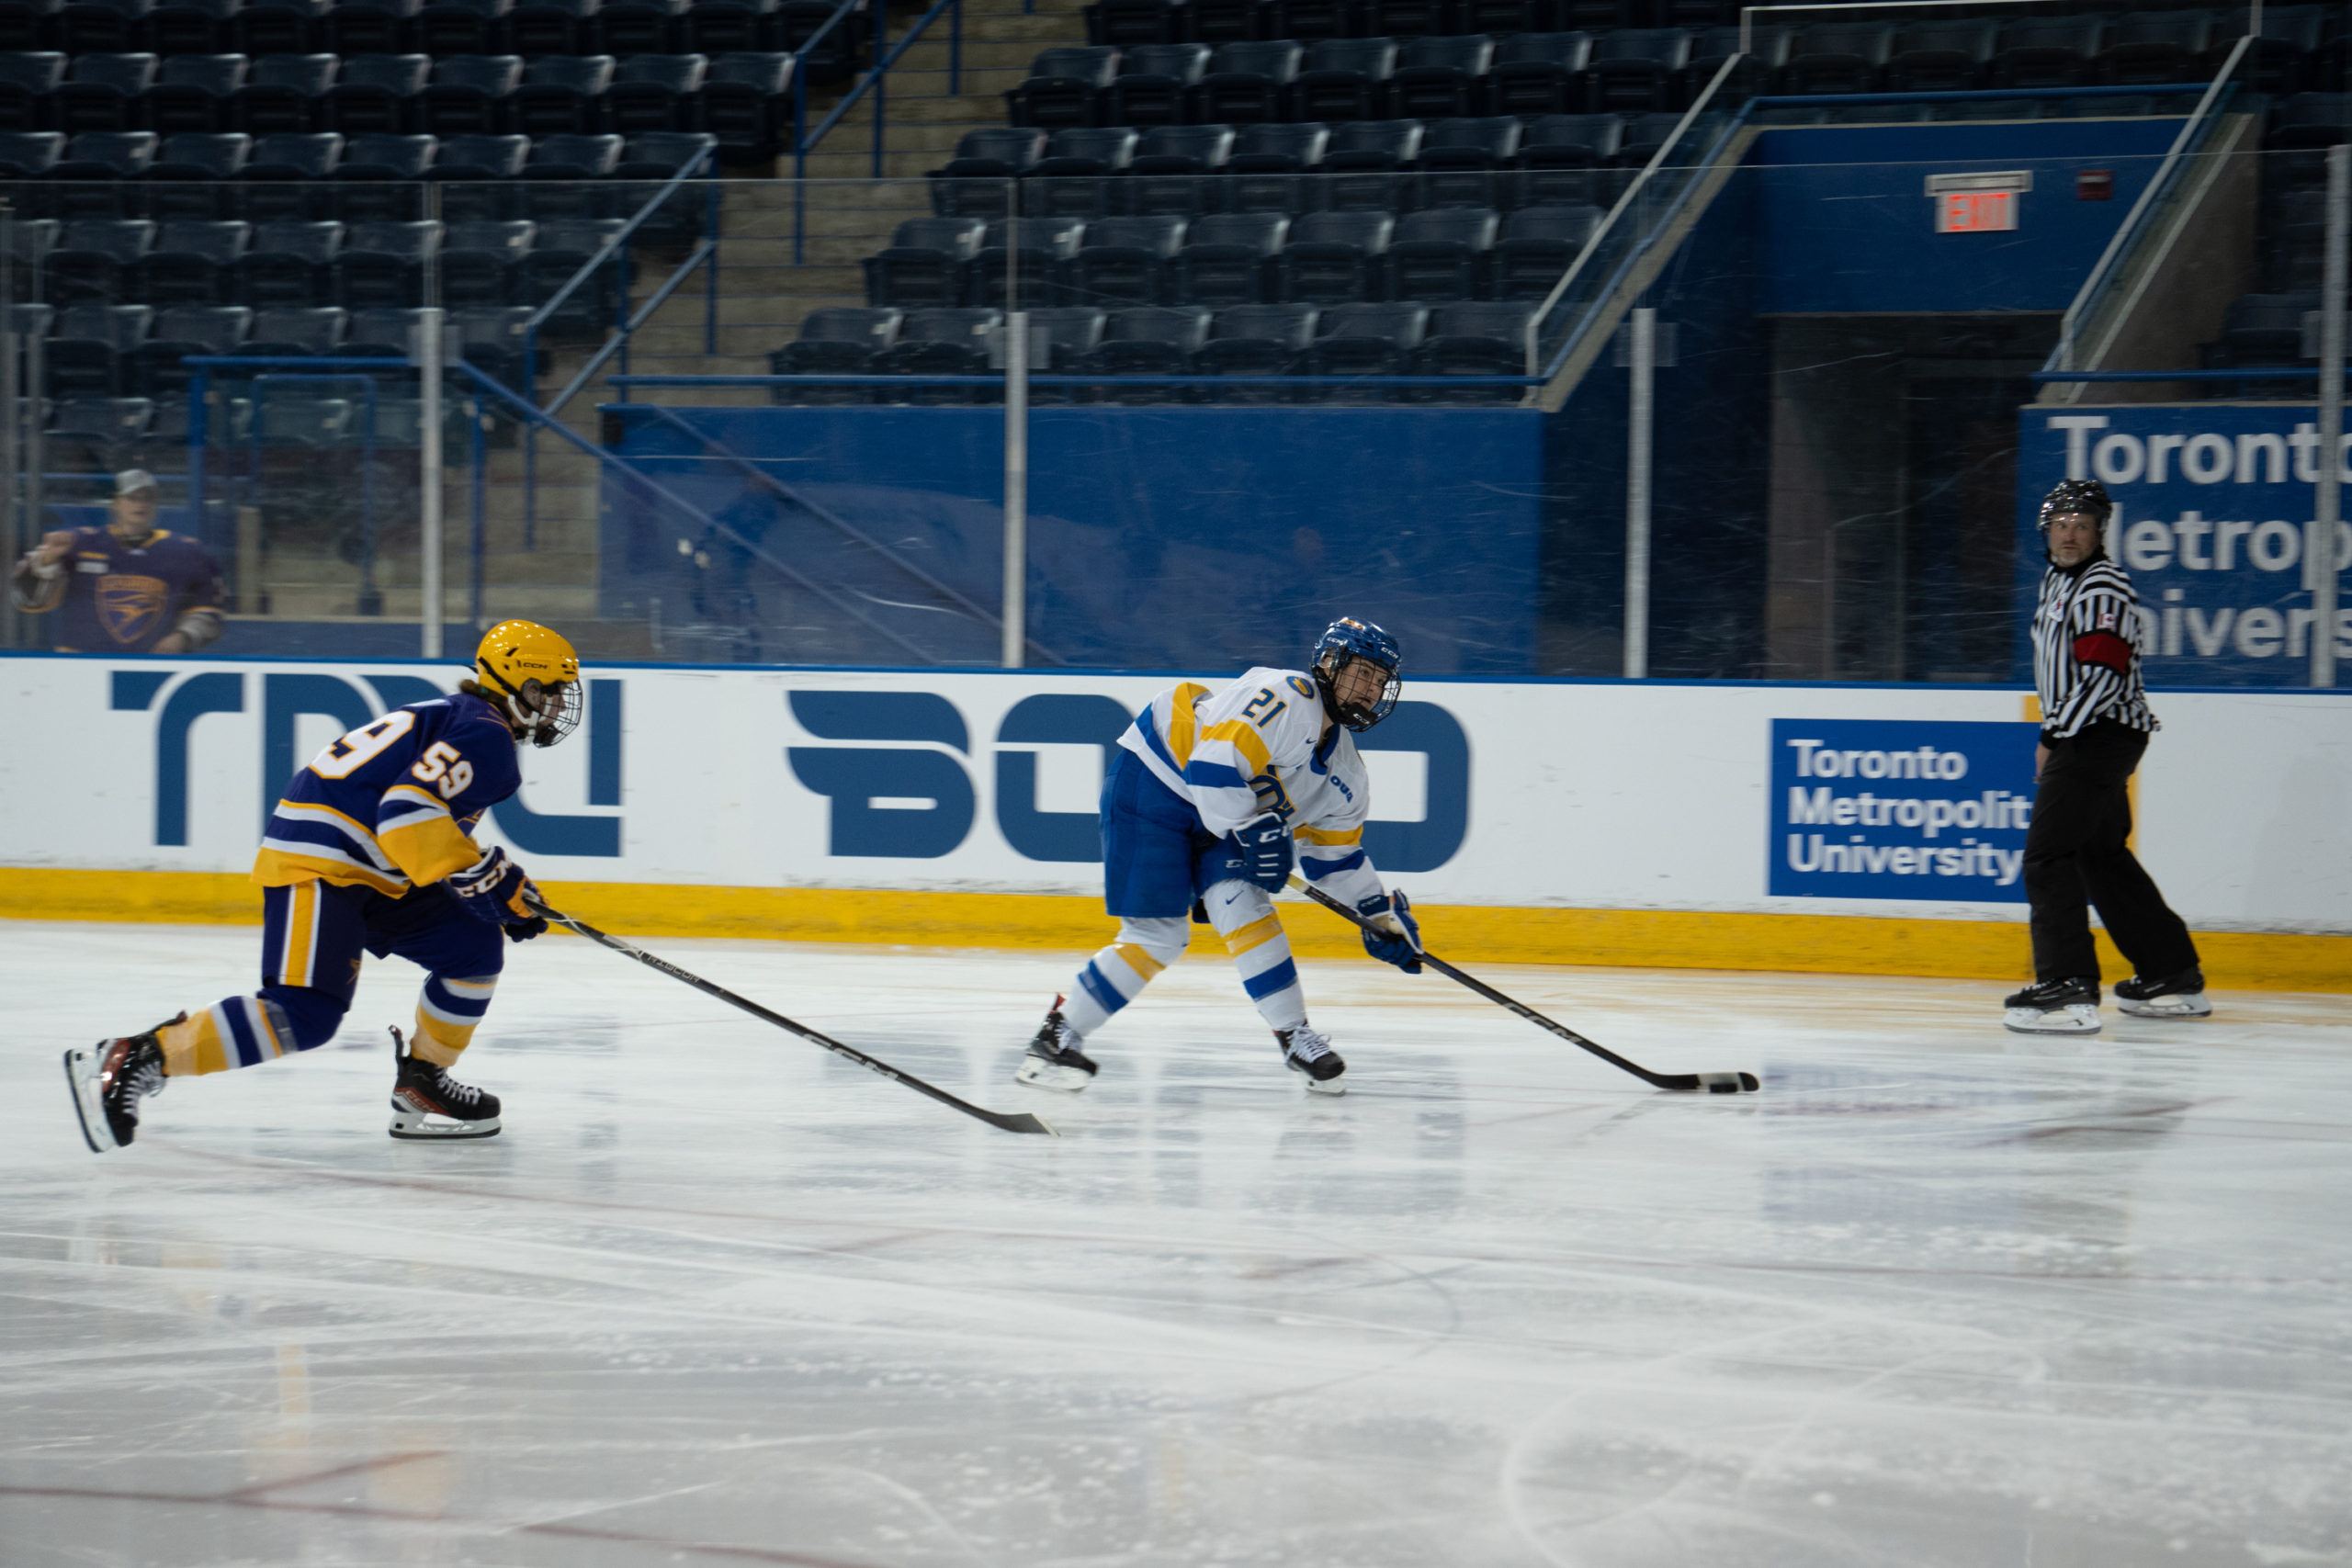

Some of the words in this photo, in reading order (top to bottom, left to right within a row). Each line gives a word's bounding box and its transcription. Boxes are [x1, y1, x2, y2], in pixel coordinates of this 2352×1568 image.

[1947, 192, 2009, 231] EXIT
[522, 661, 548, 670] CCM
[1241, 687, 1288, 730] 21
[411, 740, 474, 800] 59
[1787, 739, 1969, 781] Toronto
[1329, 774, 1354, 804] OUA
[1787, 833, 2024, 886] University
